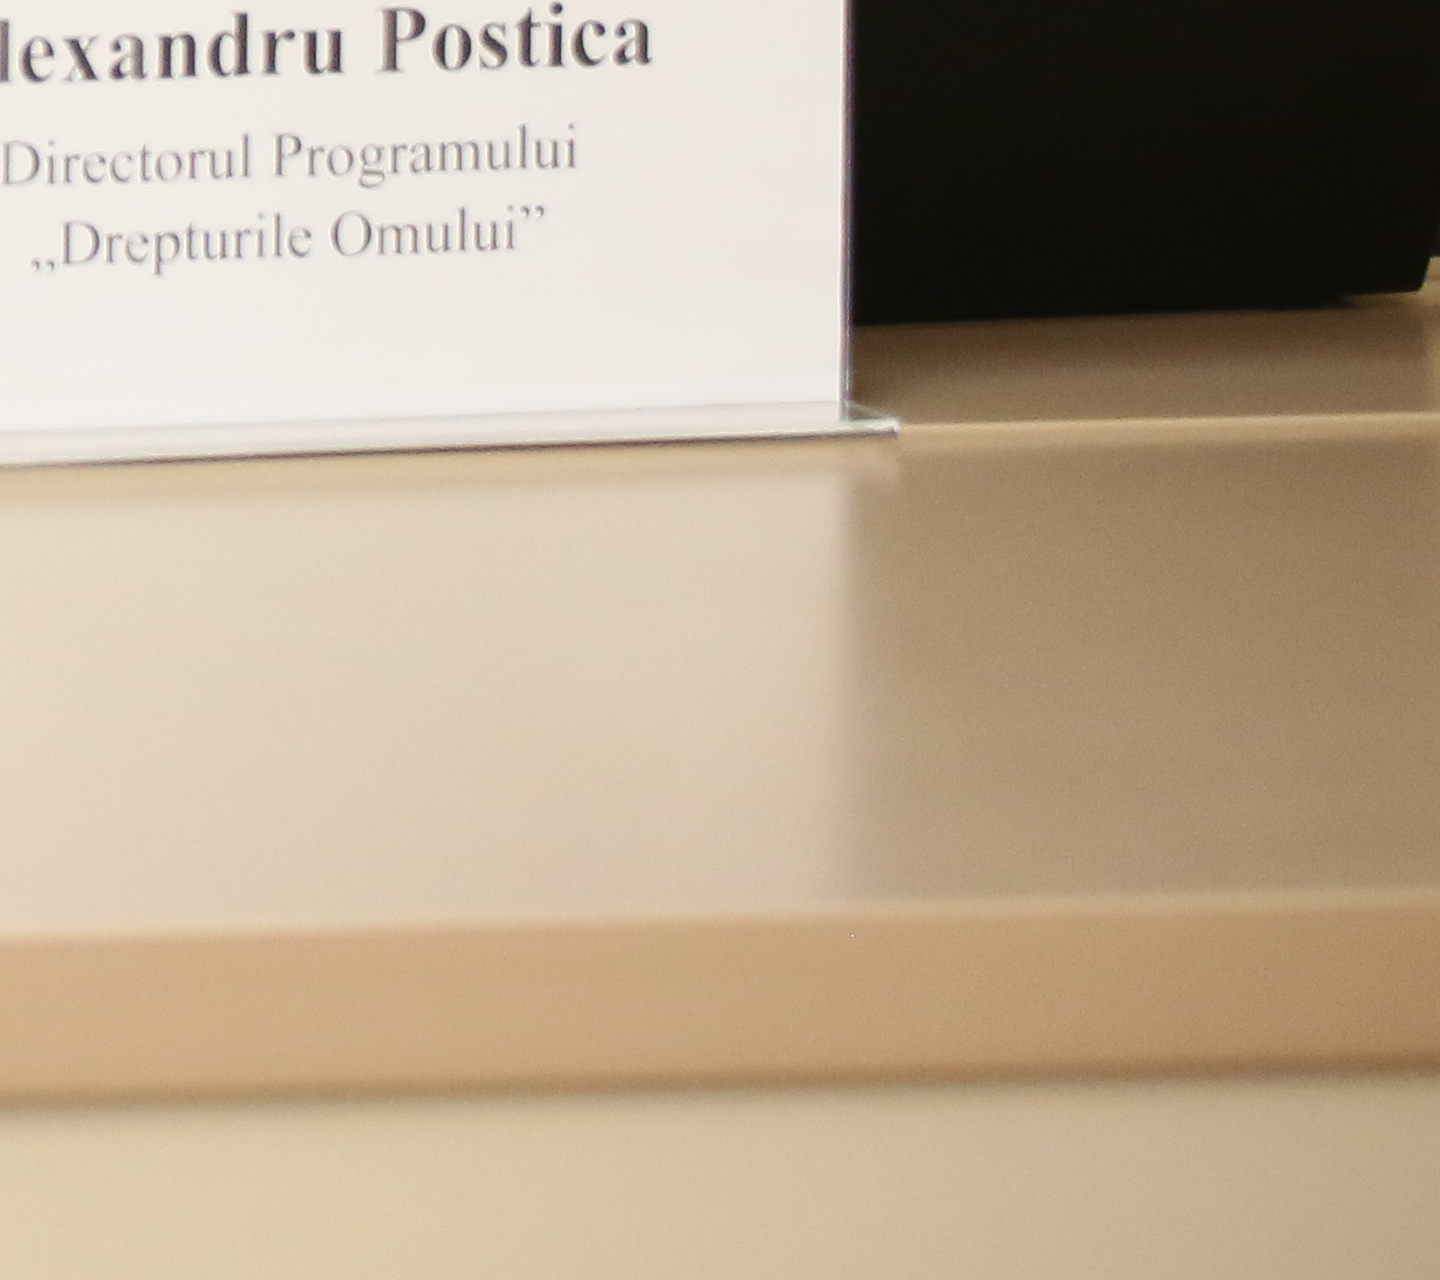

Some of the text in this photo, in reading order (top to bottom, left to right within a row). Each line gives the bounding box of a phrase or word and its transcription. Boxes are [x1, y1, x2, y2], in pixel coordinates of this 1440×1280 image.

[379, 0, 652, 74] Postica
[0, 122, 578, 190] Directorul Programului
